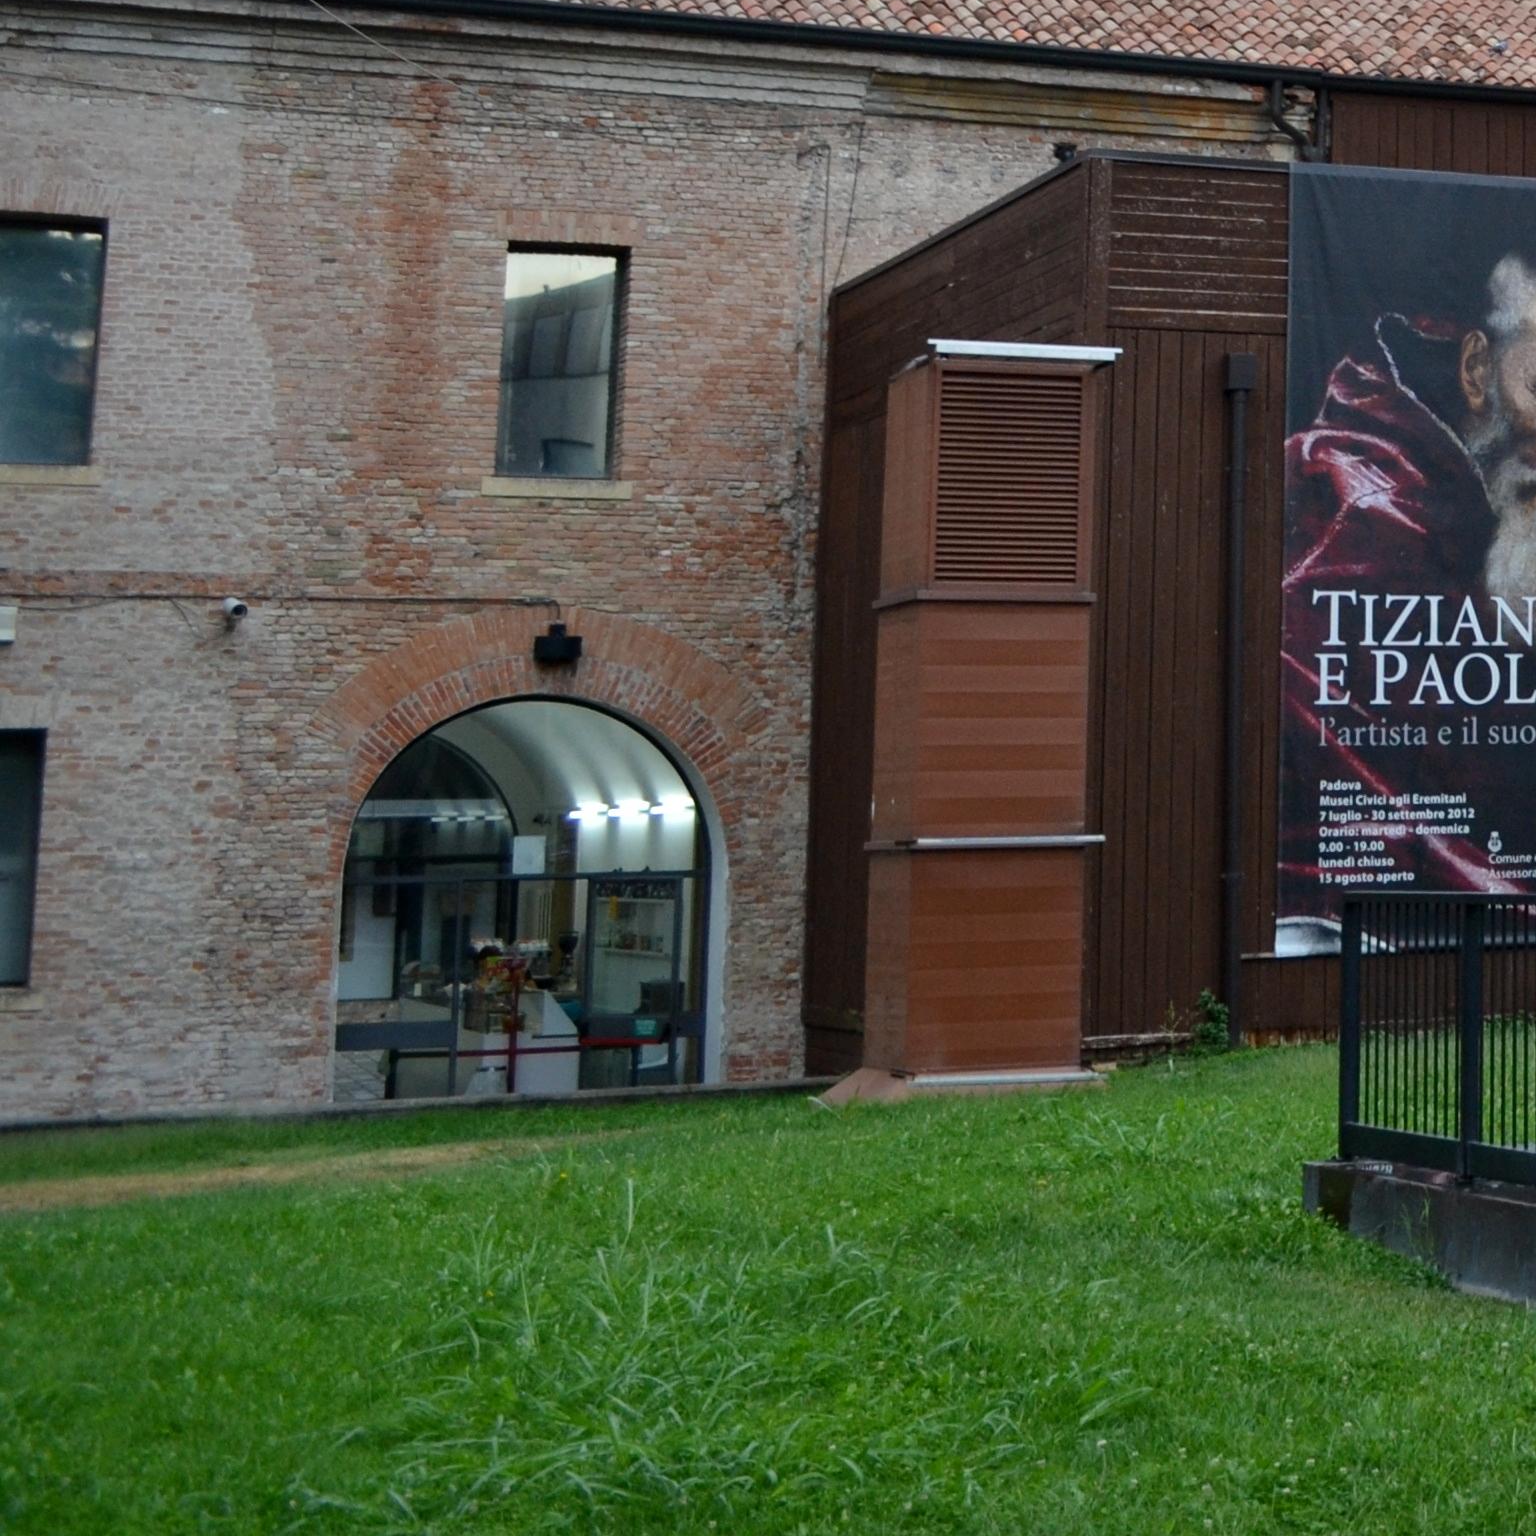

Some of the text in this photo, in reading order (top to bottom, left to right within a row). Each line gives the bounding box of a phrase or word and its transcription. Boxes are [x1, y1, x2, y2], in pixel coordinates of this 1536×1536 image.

[1313, 652, 1351, 706] E
[1319, 716, 1429, 748] l'artista
[1437, 725, 1452, 746] e
[1461, 716, 1479, 746] il
[1319, 779, 1362, 792] Padova
[1319, 792, 1467, 808] Musei Civici agli Eremitani
[1319, 811, 1328, 822] 7
[1329, 810, 1362, 824] luglio
[1371, 810, 1386, 821] 30
[1388, 808, 1446, 821] settembre
[1447, 807, 1476, 819] 2012
[1318, 825, 1360, 838] Orario:
[1361, 824, 1408, 837] martedì
[1415, 823, 1471, 835] domenica
[1318, 841, 1344, 853] 9.00
[1353, 840, 1386, 852] 19.00
[1318, 855, 1396, 868] lunedì chiuso
[1488, 853, 1532, 865] Comune
[1318, 871, 1416, 886] 15 agosto aperto
